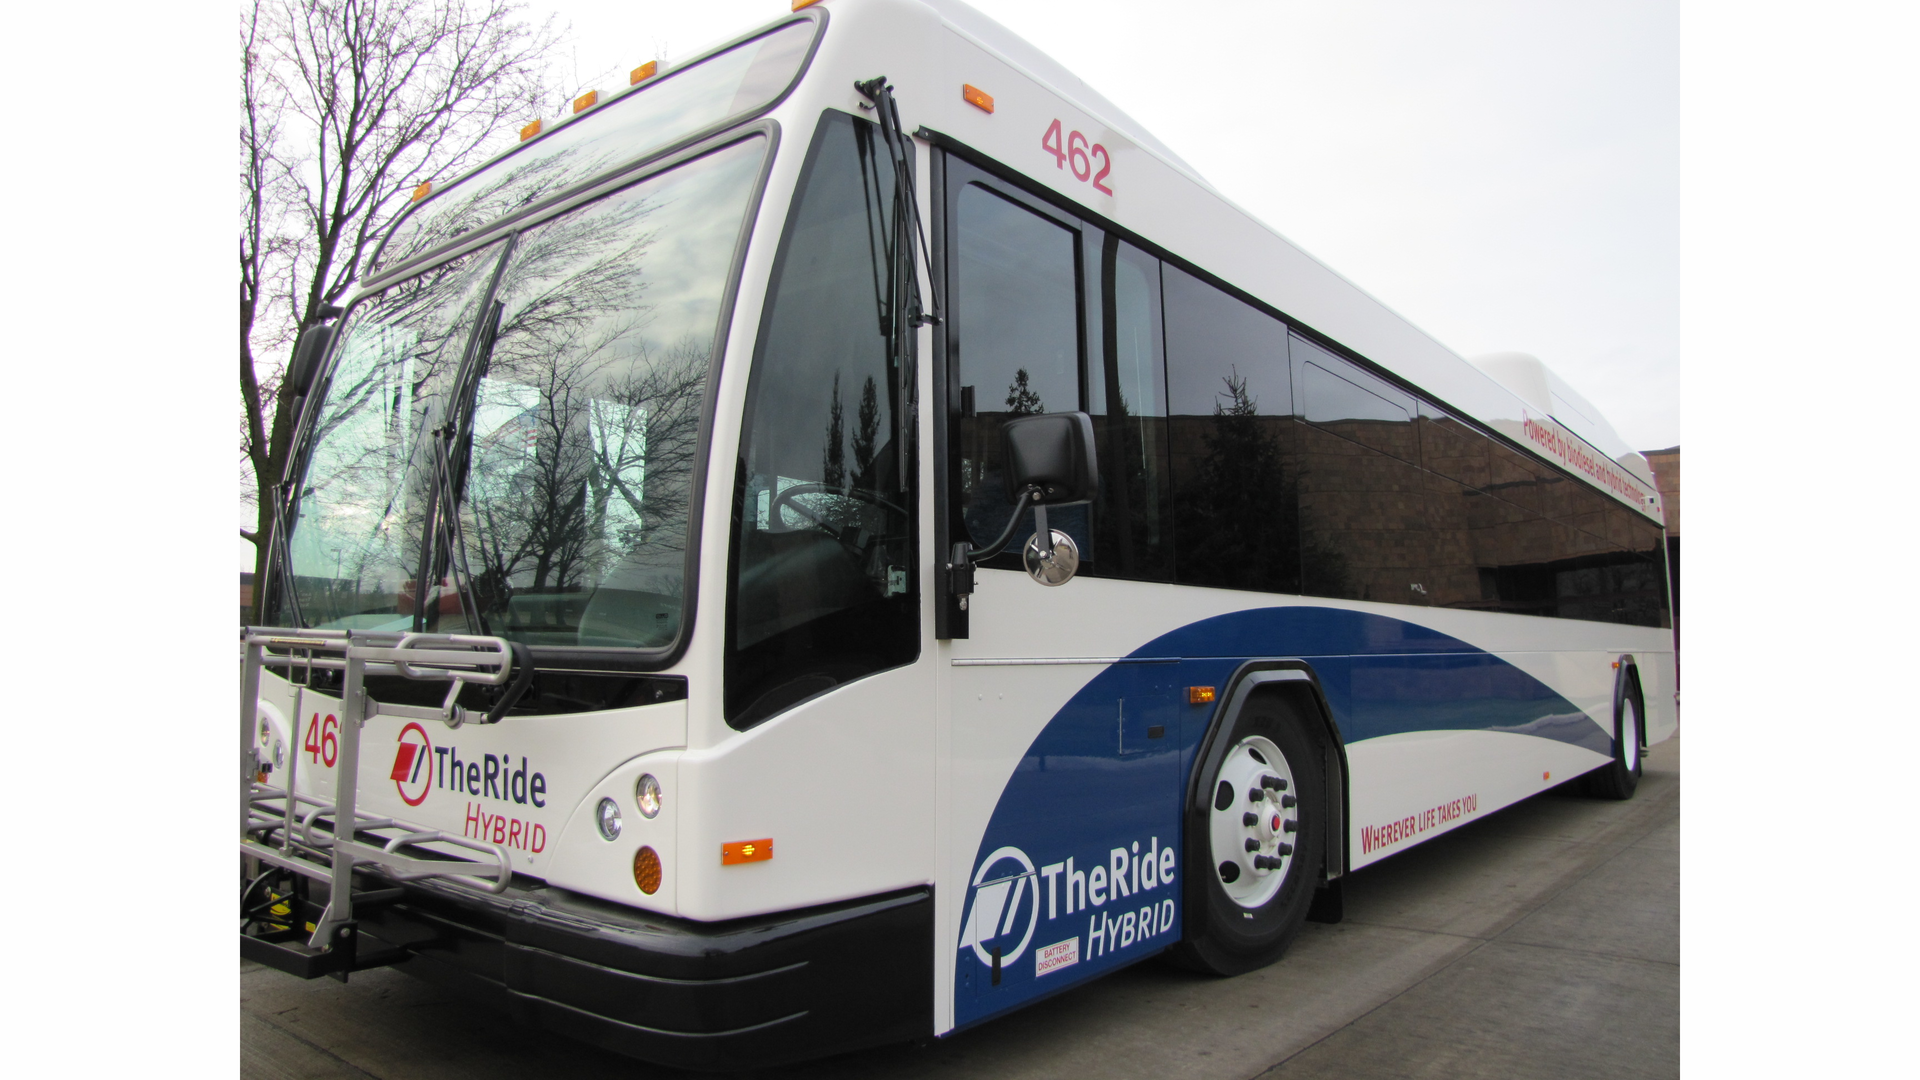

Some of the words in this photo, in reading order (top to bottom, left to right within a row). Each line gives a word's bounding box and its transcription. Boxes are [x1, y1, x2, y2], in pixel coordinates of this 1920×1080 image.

[1042, 118, 1112, 197] 462
[1522, 408, 1557, 454] Powered
[1557, 430, 1566, 467] by
[1566, 437, 1596, 478] biodiesel
[1595, 460, 1607, 485] and
[305, 712, 343, 768] 46
[435, 746, 547, 808] TheRide
[464, 801, 547, 854] HYBRID
[1361, 815, 1416, 855] WHEREVER
[1418, 808, 1436, 833] LIFE
[1437, 799, 1461, 825] TAKES
[1462, 793, 1477, 815] YOU
[1041, 836, 1176, 920] TheRide
[1044, 943, 1071, 959] BATTERY
[1086, 898, 1175, 961] HYBRID
[1038, 951, 1076, 971] DISCONNECT
